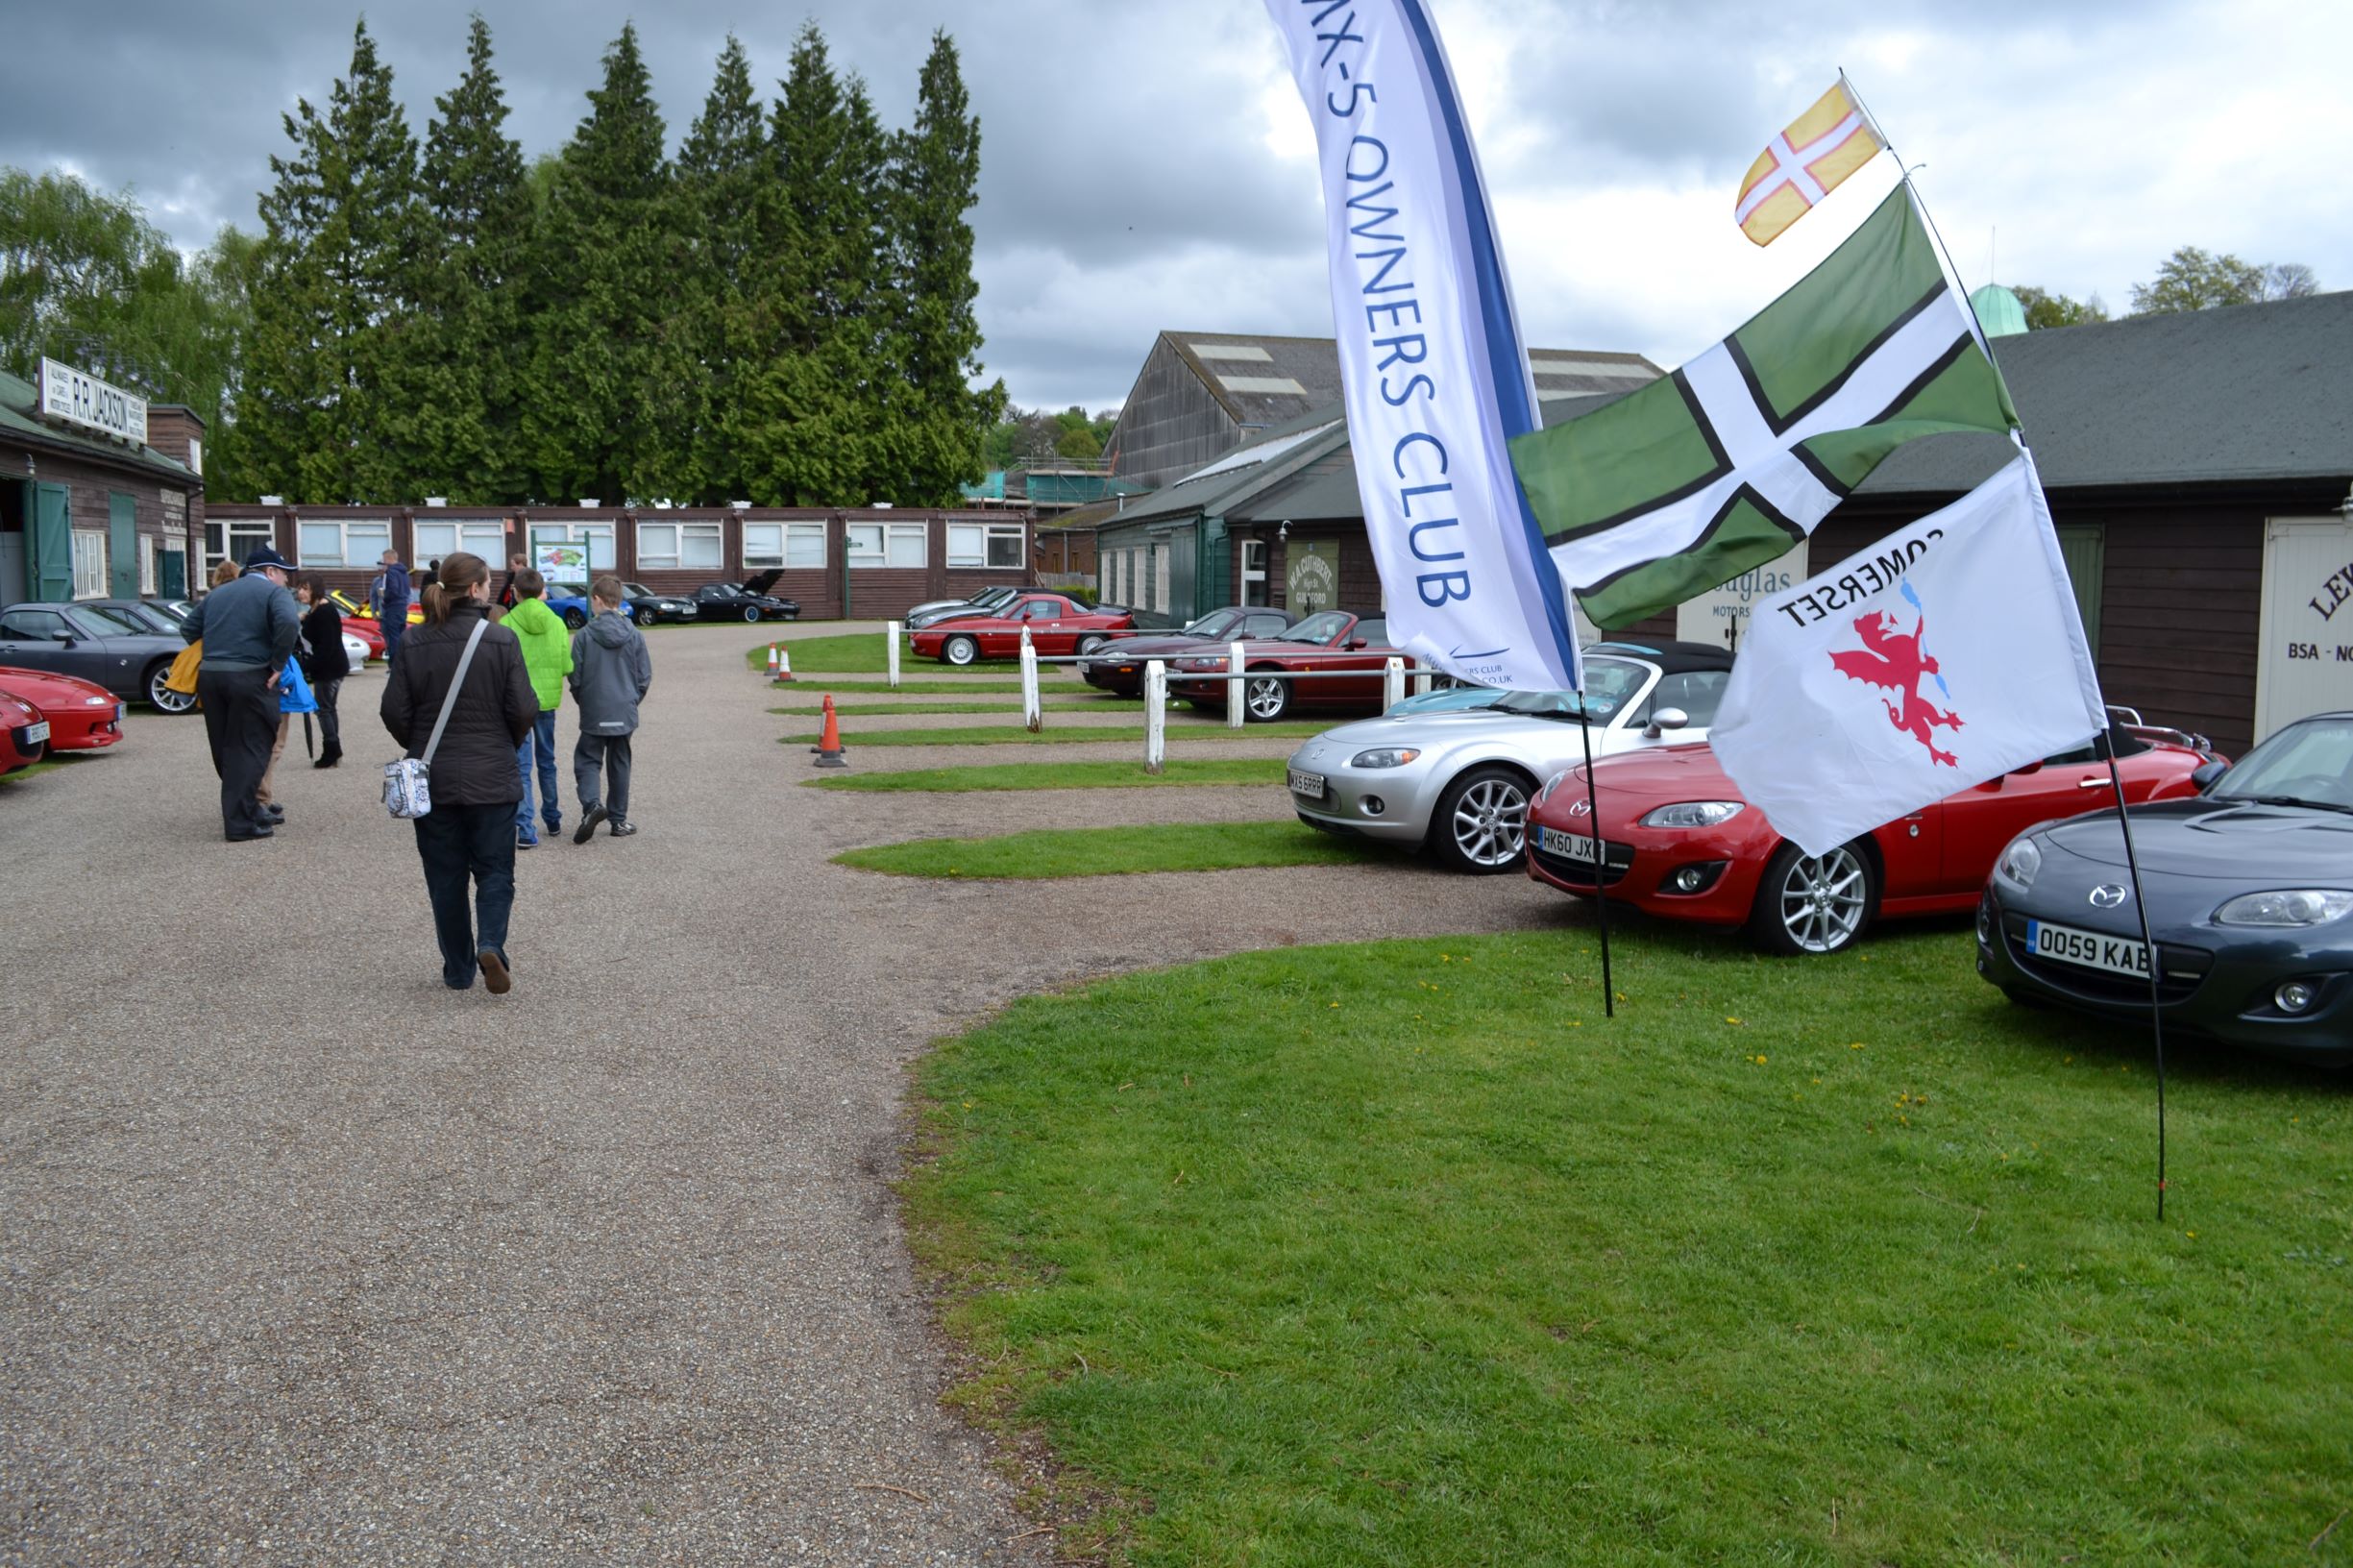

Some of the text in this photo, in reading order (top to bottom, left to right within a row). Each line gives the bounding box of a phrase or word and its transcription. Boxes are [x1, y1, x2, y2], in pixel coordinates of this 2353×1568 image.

[1346, 135, 1435, 406] OWNERS
[1393, 432, 1471, 607] CLUB
[93, 385, 128, 433] JACKSON
[1712, 605, 1751, 618] MOTORS
[2288, 643, 2319, 660] BSA
[1481, 664, 1503, 674] CLUB
[1544, 829, 1572, 854] HK60
